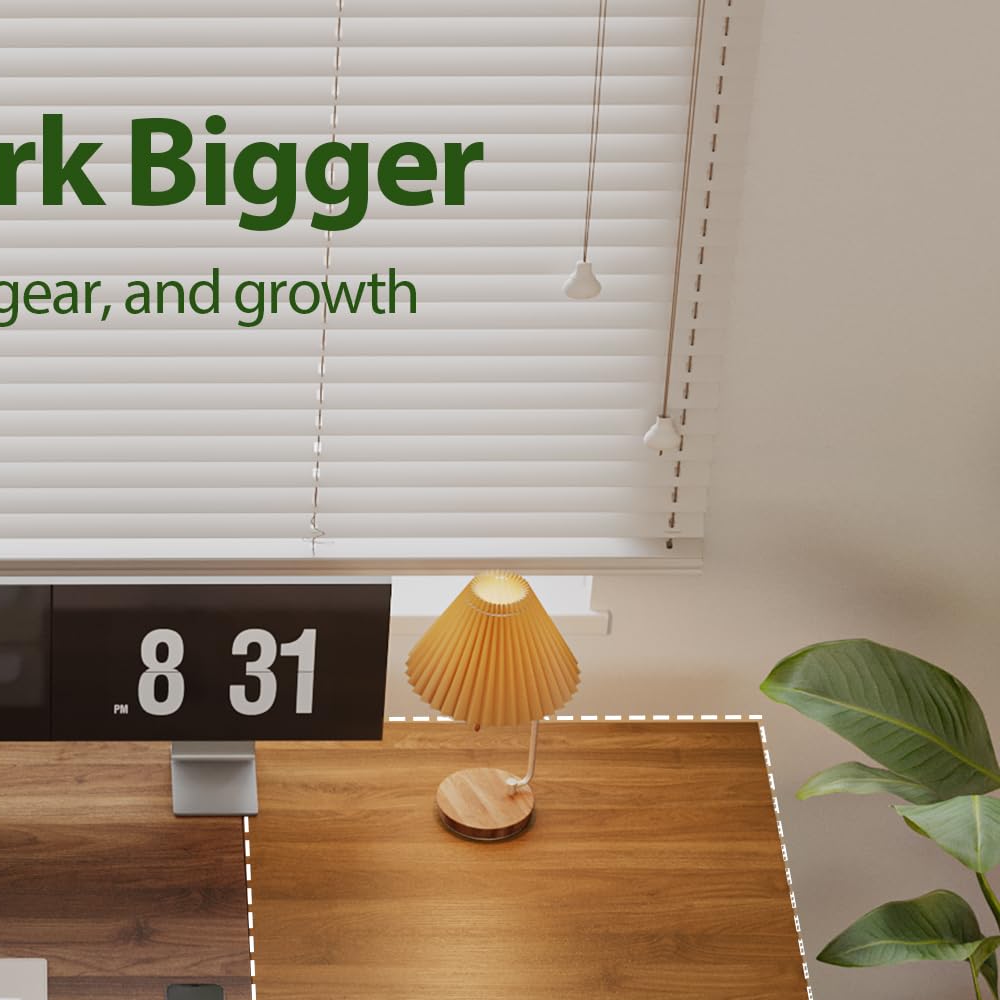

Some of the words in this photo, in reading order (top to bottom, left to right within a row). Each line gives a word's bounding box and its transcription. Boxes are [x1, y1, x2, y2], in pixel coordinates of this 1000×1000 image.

[113, 703, 129, 714] PM
[138, 628, 185, 716] 8
[229, 628, 317, 716] 31
